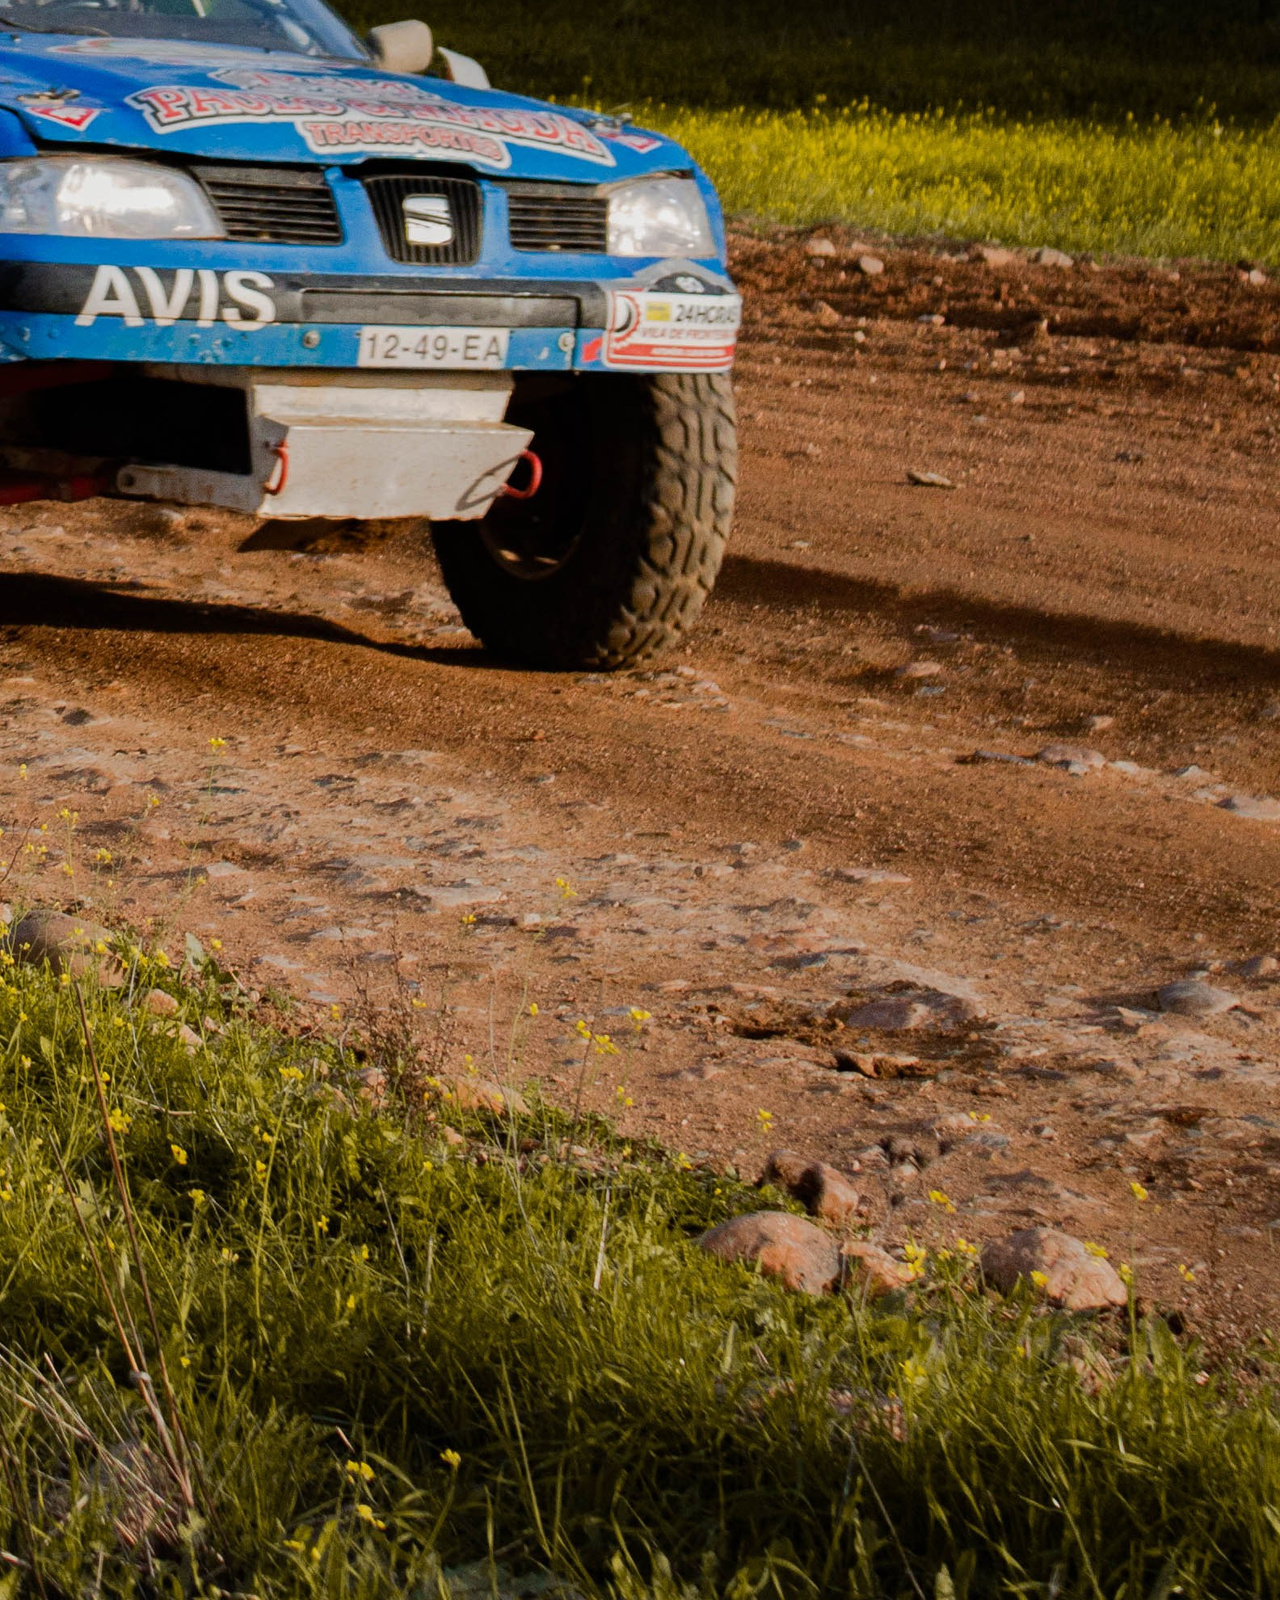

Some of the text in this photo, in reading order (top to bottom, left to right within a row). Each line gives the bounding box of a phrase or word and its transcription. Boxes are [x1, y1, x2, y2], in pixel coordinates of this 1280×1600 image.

[131, 89, 348, 128] PAULO
[304, 121, 505, 161] TRANSPORTES
[74, 264, 278, 331] AVIS
[365, 332, 505, 362] 12-49-EA
